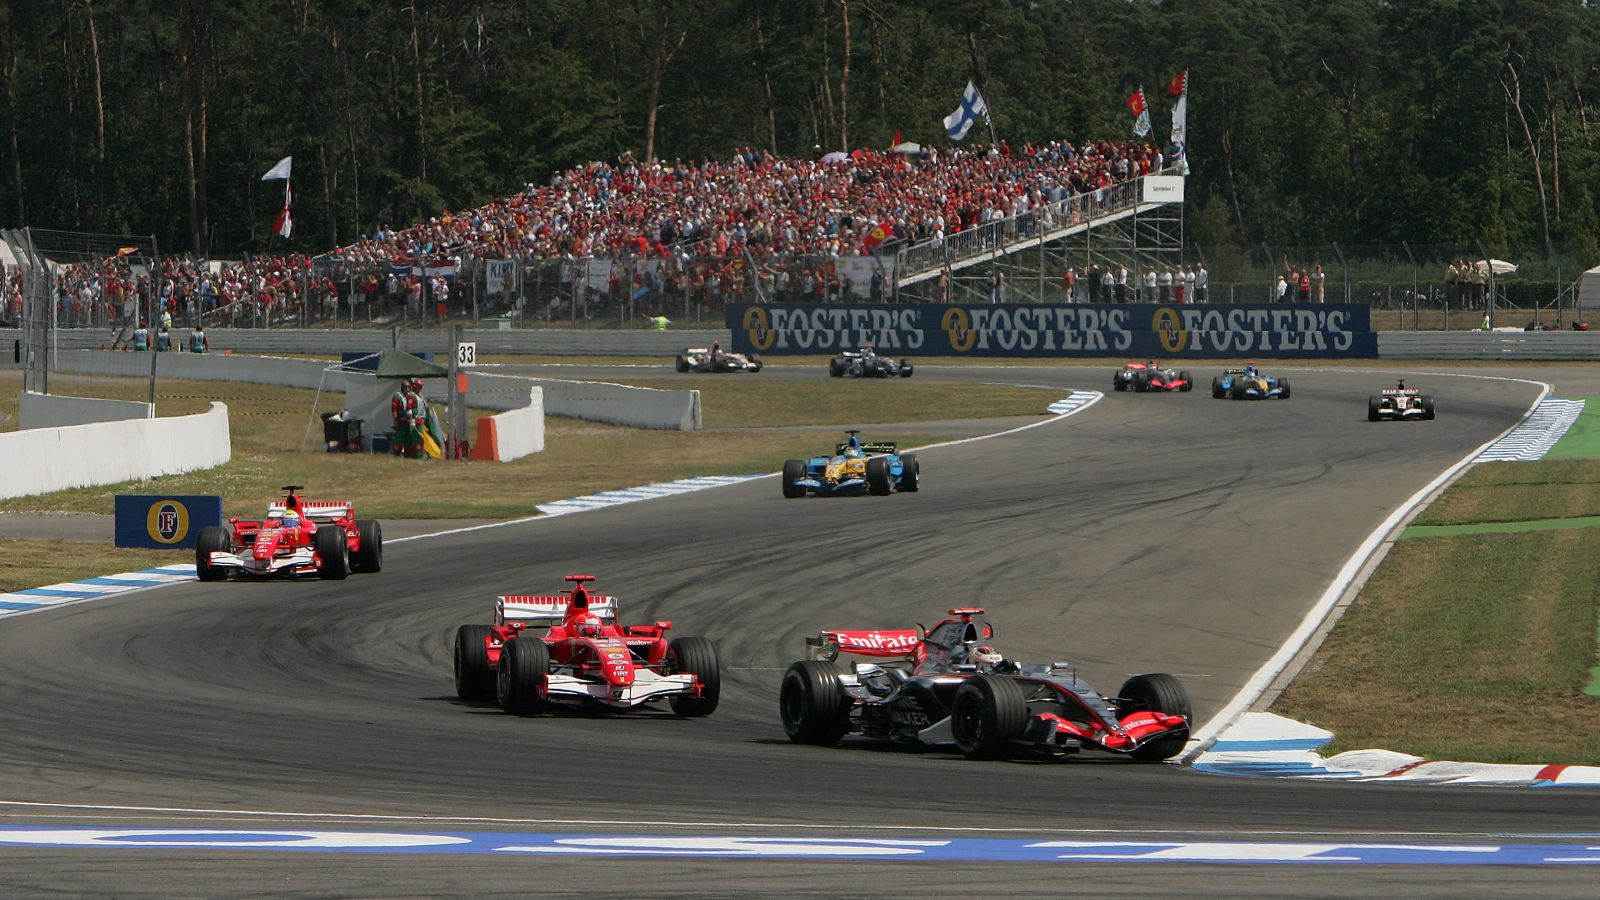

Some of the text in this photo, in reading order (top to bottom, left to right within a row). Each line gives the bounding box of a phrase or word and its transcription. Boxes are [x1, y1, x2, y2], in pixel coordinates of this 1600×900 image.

[769, 308, 925, 349] FOSTER'S
[969, 308, 1132, 350] FOSTER'S
[1181, 309, 1353, 351] FOSTER'S
[460, 346, 473, 363] 33
[161, 511, 178, 533] F
[1121, 719, 1158, 731] mirates
